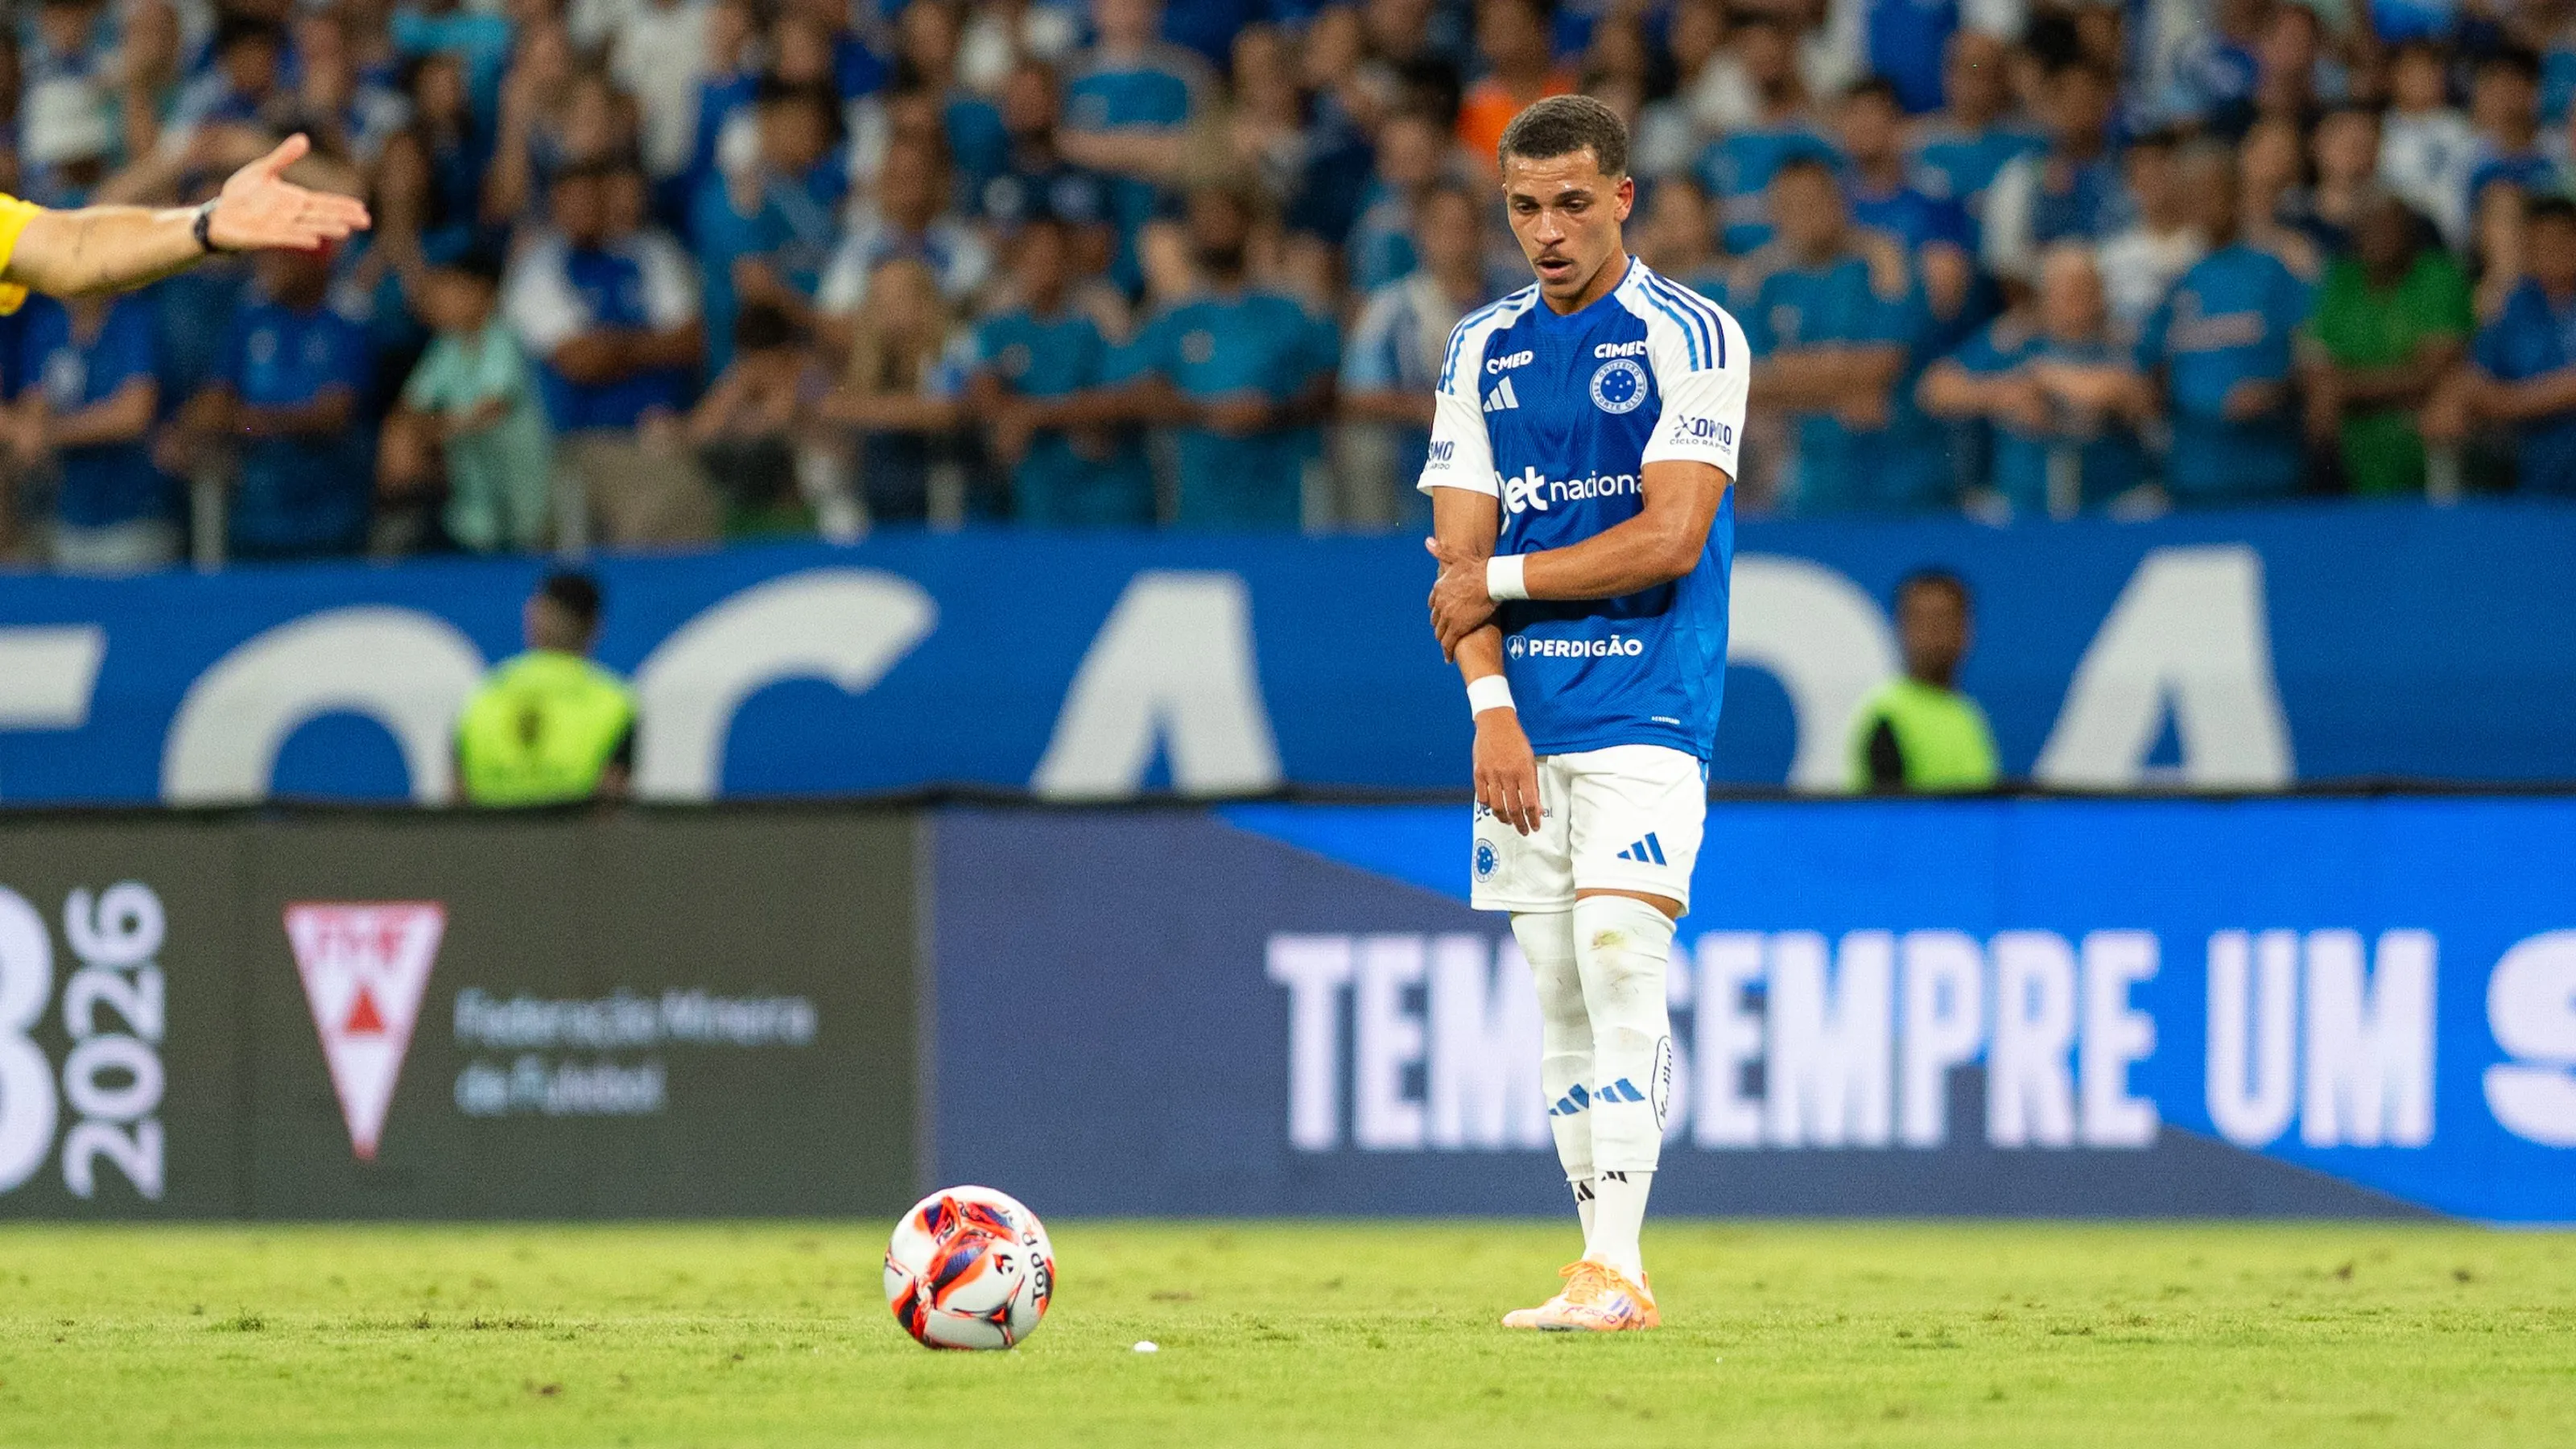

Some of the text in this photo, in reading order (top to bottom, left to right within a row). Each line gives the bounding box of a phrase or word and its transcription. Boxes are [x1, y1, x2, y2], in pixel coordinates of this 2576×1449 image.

[1486, 350, 1534, 374] CMED
[1550, 470, 1643, 502] nacion
[1530, 634, 1643, 658] PERDIGÃO
[62, 879, 167, 1199] 2026
[1668, 928, 2161, 1151] EMPRE
[2206, 928, 2438, 1151] UM
